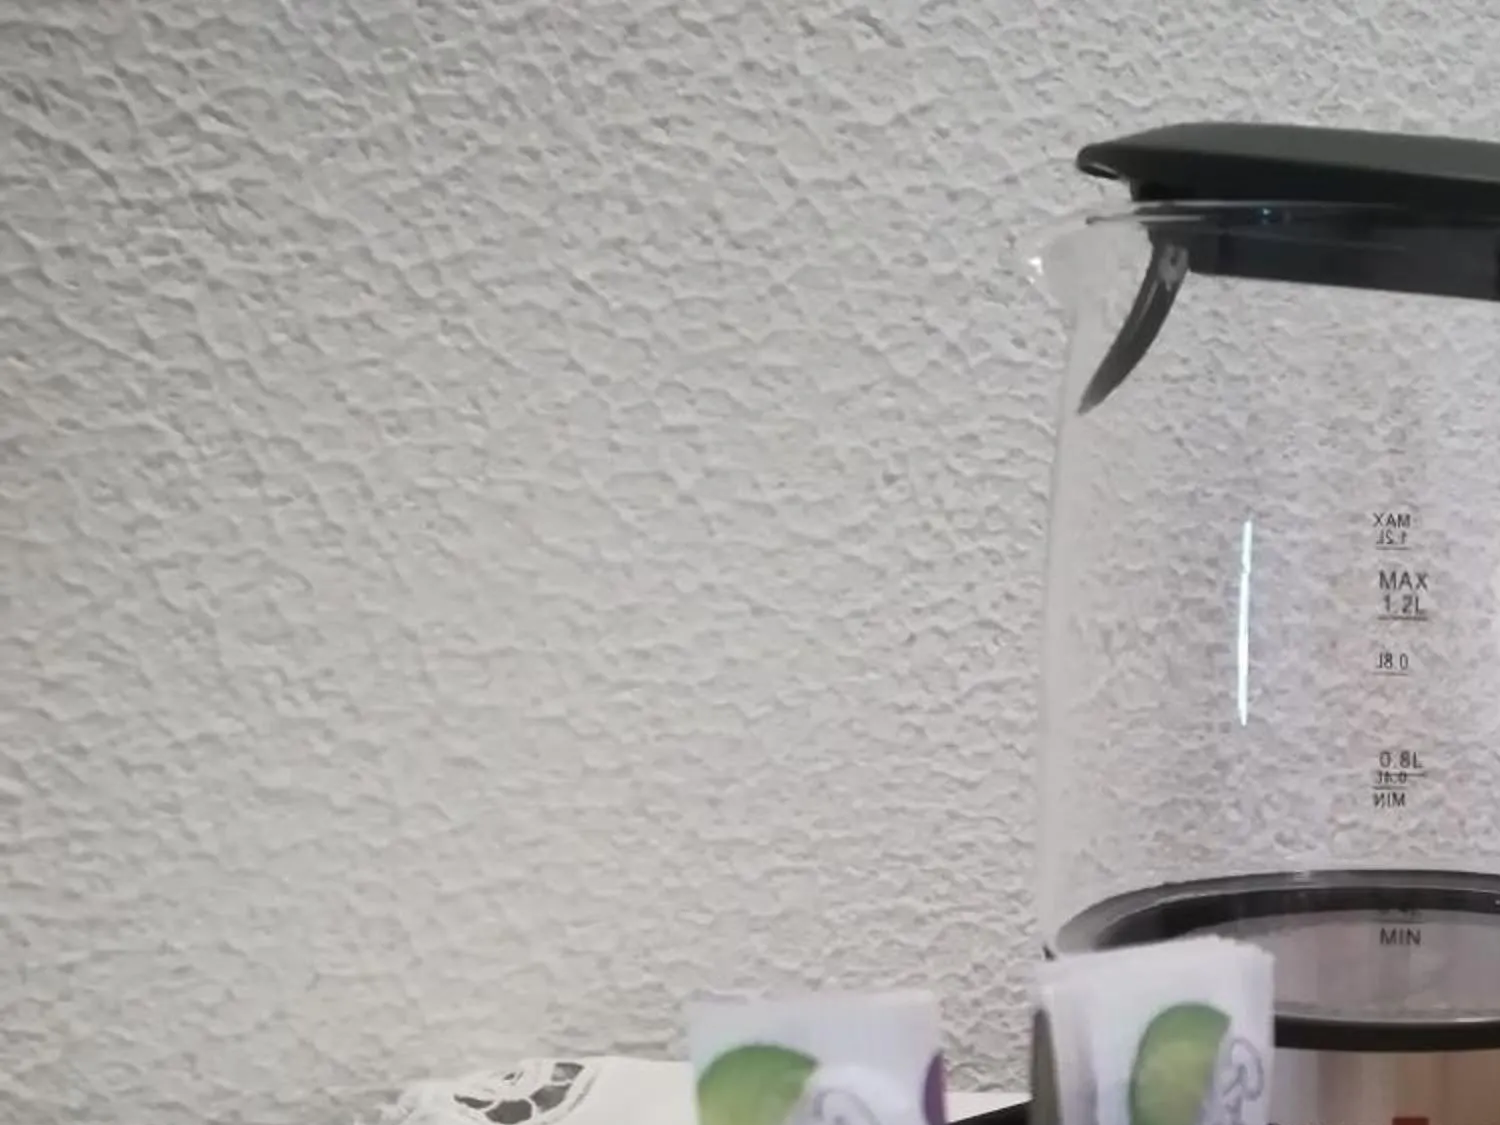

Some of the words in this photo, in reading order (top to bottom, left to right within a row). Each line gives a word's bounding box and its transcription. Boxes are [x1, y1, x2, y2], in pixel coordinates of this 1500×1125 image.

[1379, 571, 1428, 591] MAX
[1380, 750, 1423, 769] 0.8L
[1380, 927, 1421, 946] MIN
